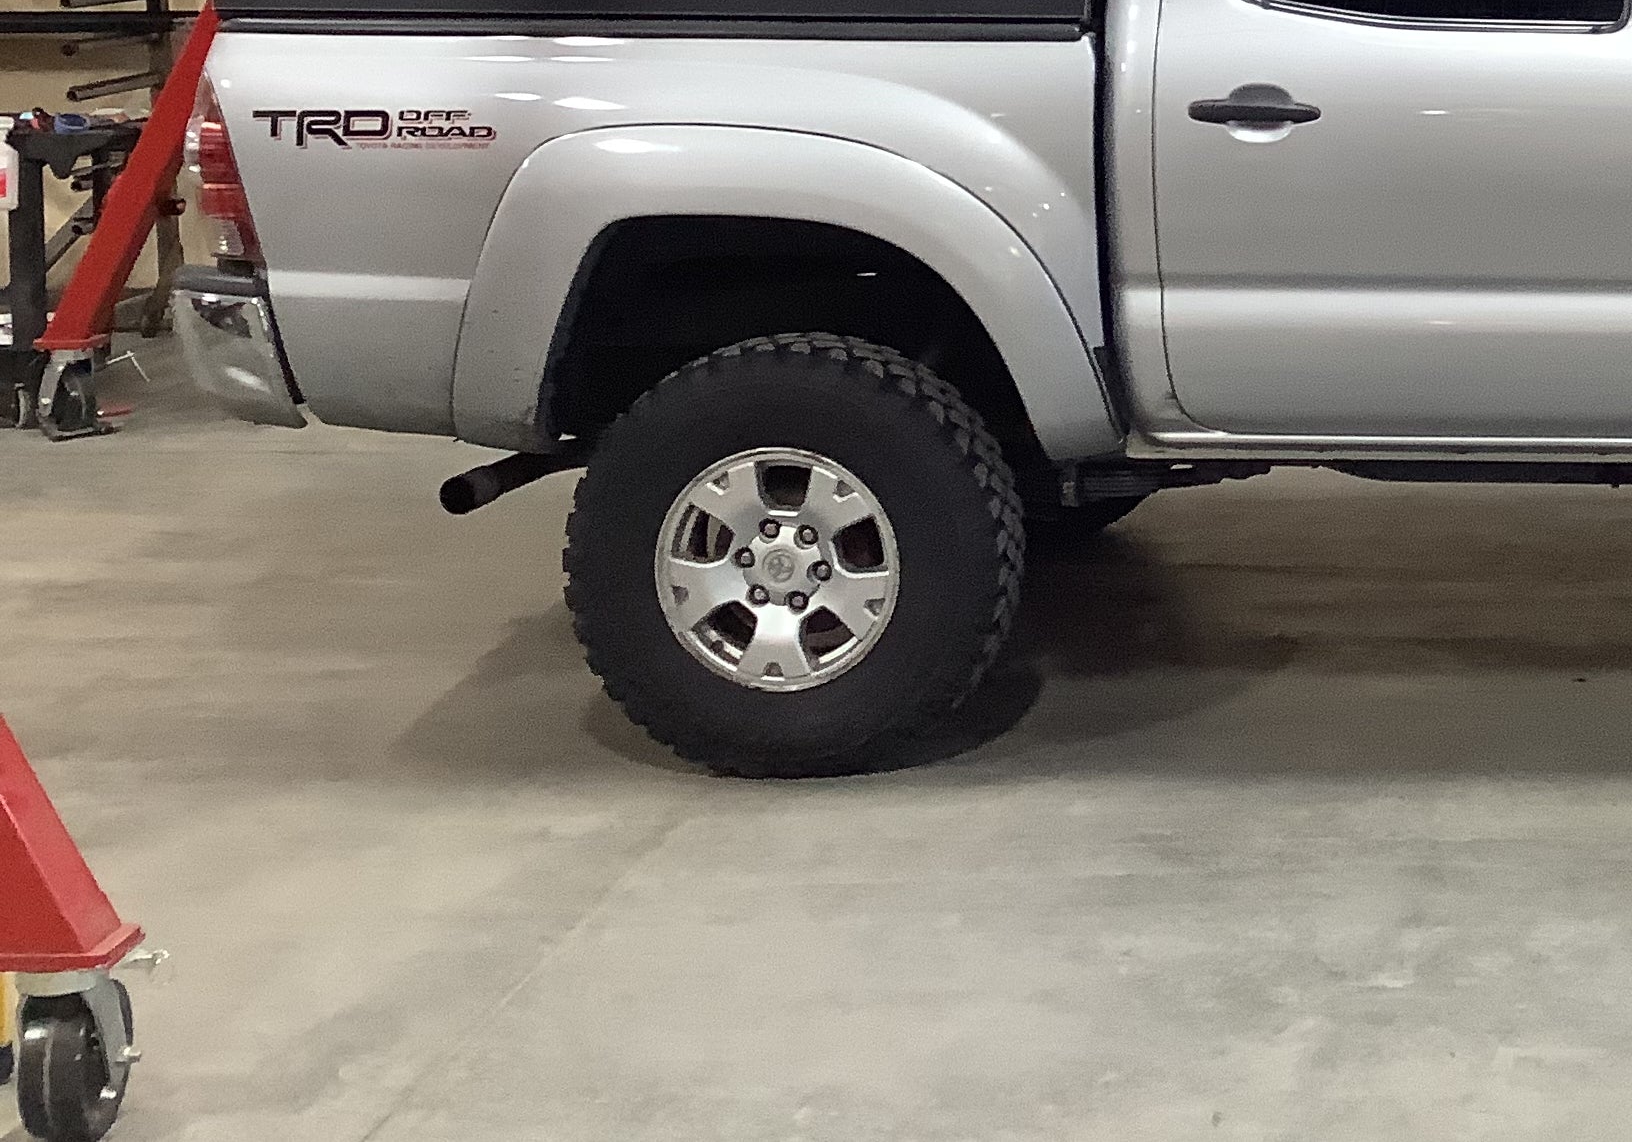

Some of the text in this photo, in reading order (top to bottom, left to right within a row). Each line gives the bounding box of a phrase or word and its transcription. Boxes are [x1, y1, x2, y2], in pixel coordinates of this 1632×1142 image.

[398, 110, 469, 123] OFF
[252, 110, 391, 148] TRD
[396, 126, 496, 139] ROAD
